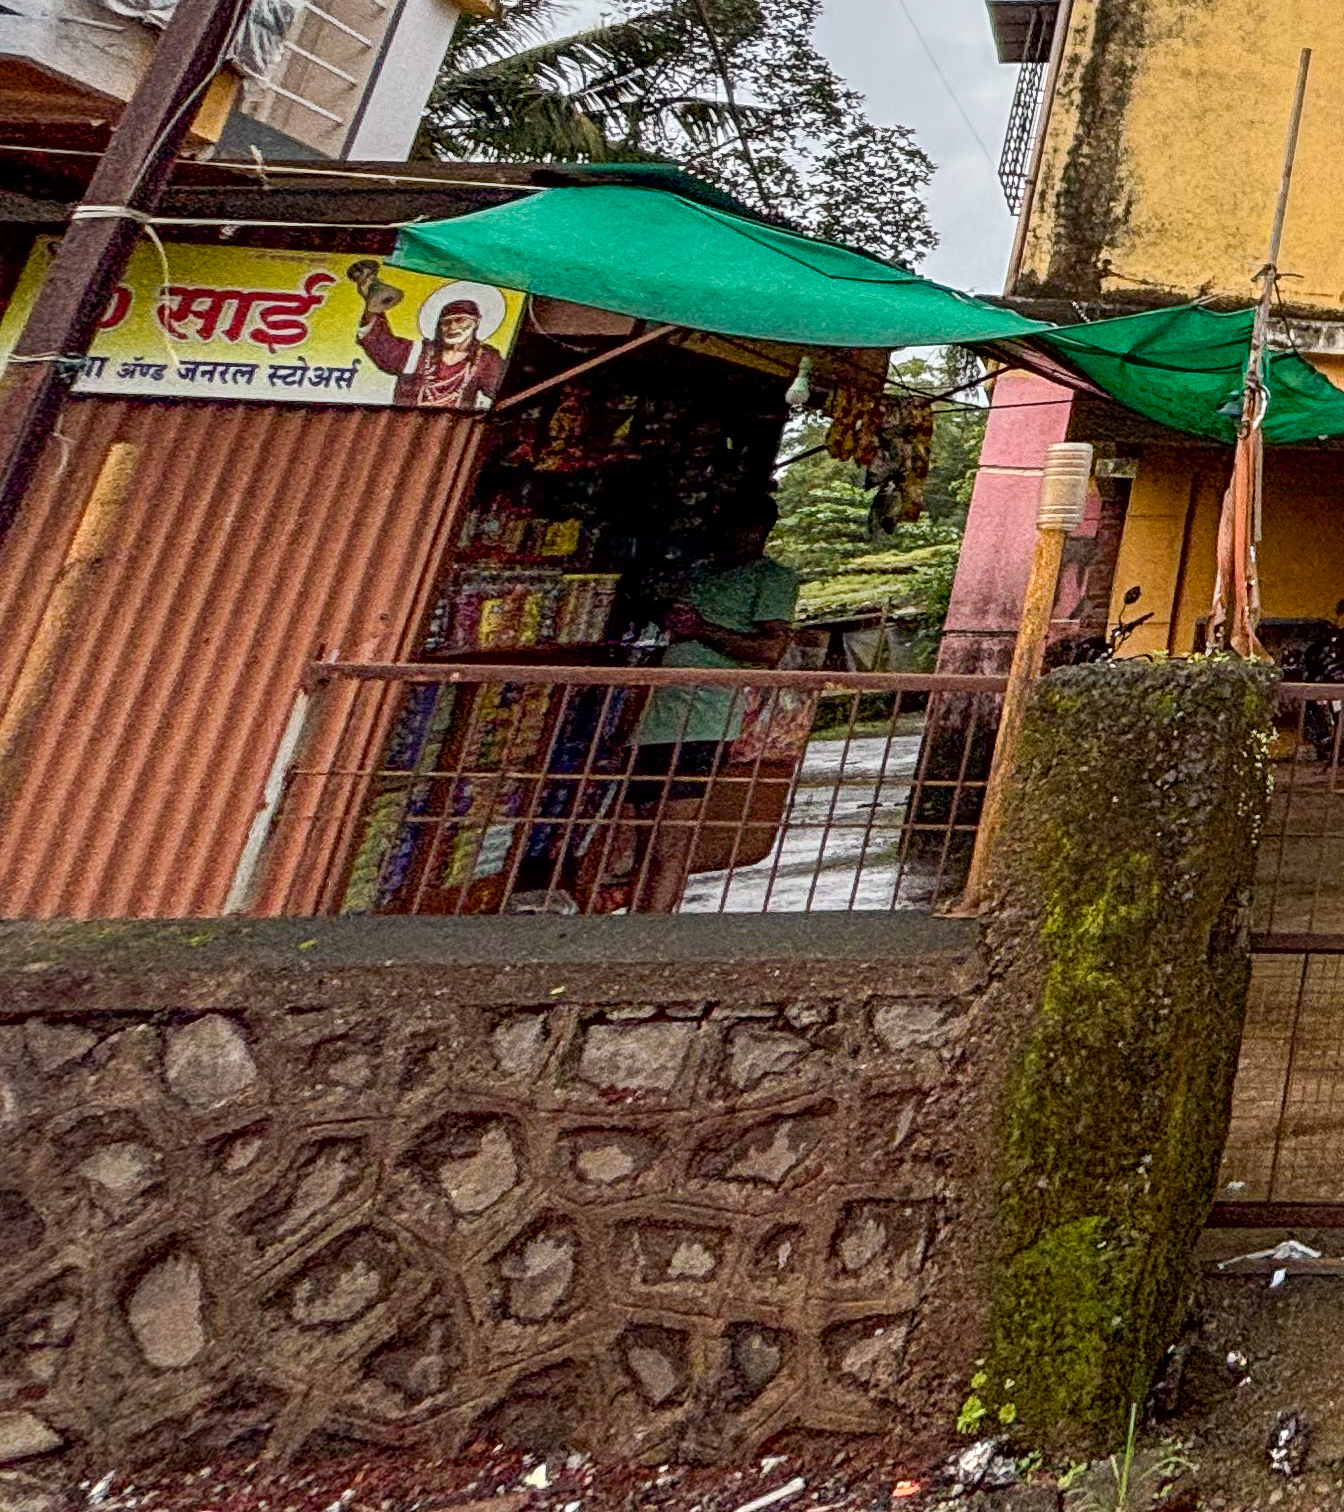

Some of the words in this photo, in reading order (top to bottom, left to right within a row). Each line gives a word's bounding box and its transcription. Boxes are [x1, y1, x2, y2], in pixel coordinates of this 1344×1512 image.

[157, 272, 337, 354] साई
[177, 360, 260, 385] जनरल
[267, 355, 362, 389] स्टोअर्स
